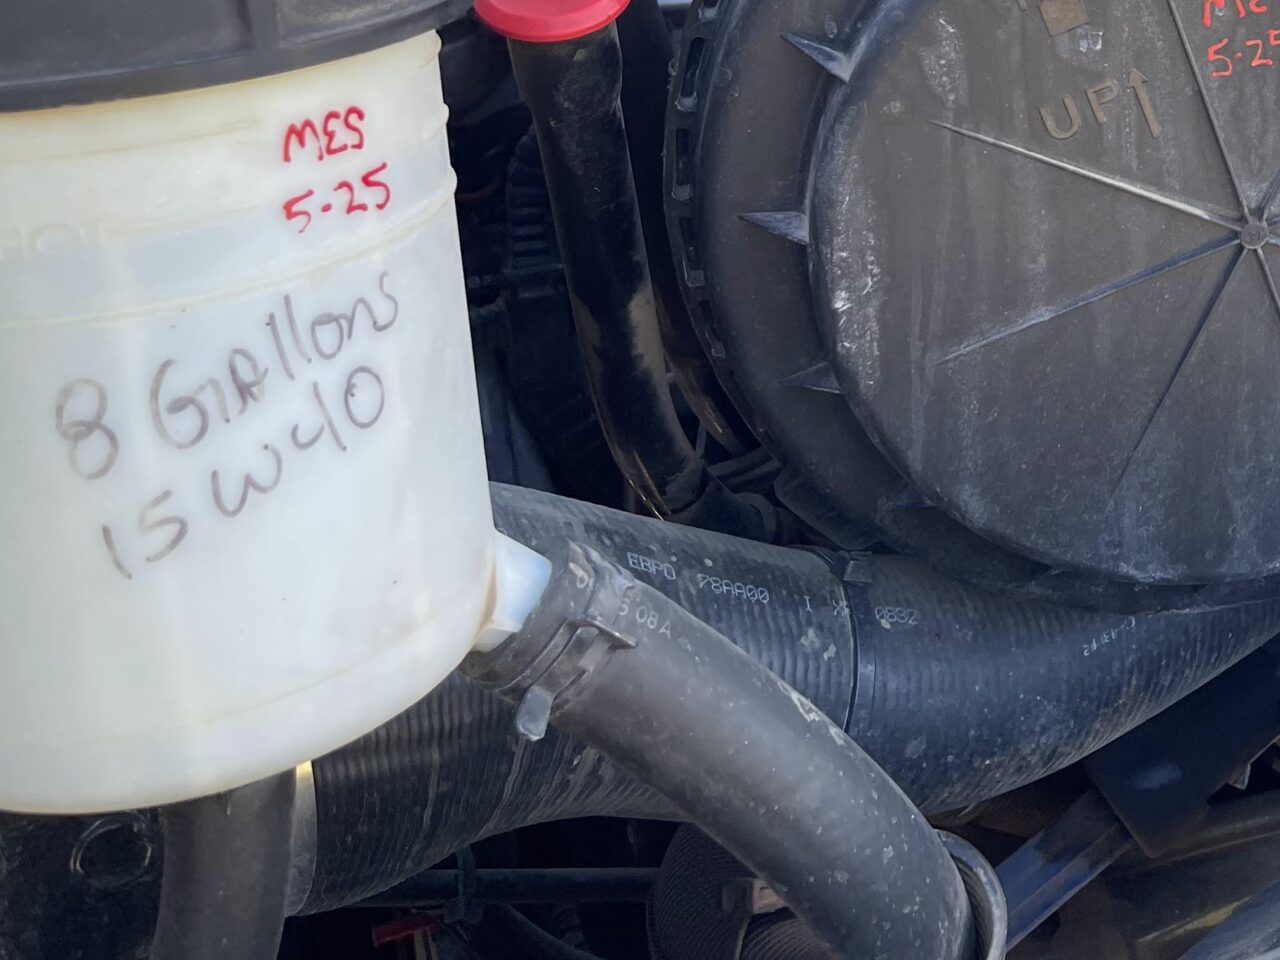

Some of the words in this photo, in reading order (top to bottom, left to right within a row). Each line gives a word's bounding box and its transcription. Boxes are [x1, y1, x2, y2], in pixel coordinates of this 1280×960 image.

[283, 105, 366, 163] MES
[1039, 80, 1120, 140] UP
[55, 377, 119, 481] 8
